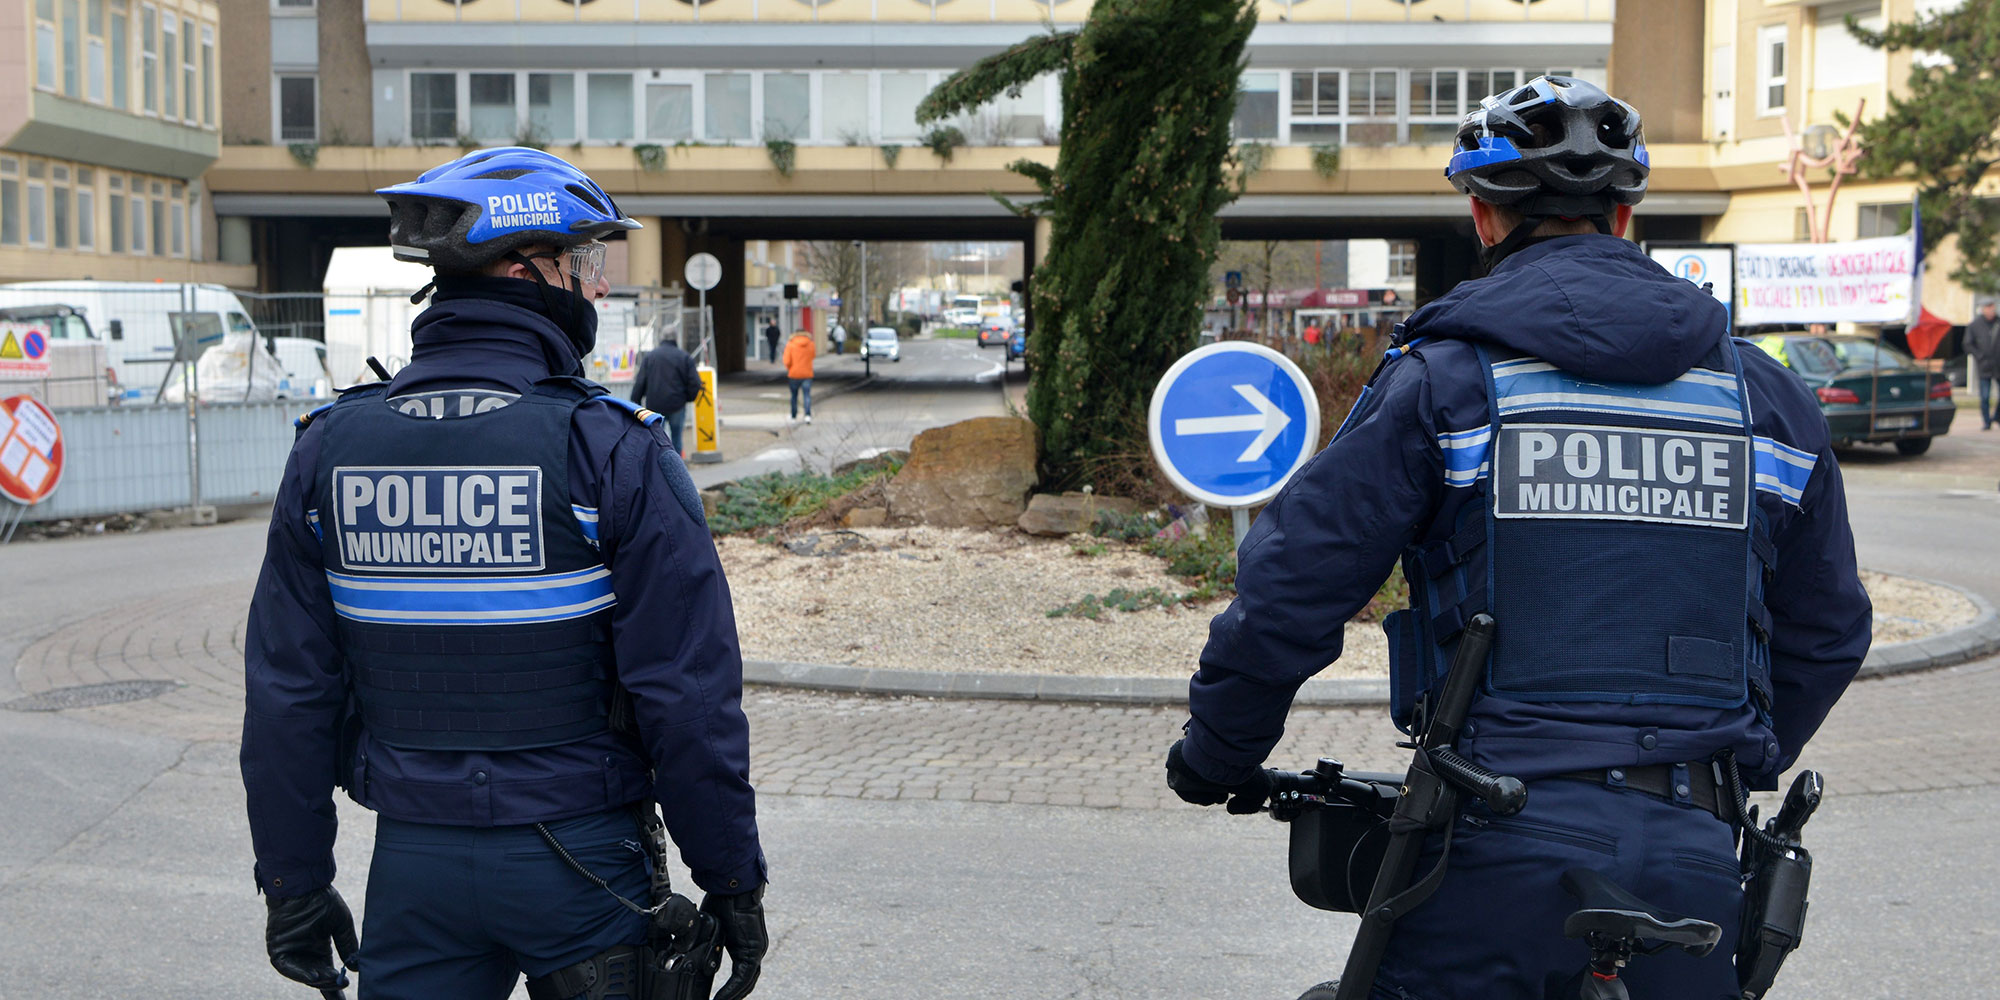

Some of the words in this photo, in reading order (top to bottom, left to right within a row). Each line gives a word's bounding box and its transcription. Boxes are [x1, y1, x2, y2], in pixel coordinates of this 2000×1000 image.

[487, 191, 559, 216] POLICE
[491, 211, 561, 229] MUNICIPALE
[1518, 431, 1730, 488] POLICE
[342, 474, 530, 527] POLICE
[1518, 483, 1729, 521] MUNICIPALE
[345, 531, 533, 564] MUNICIPALE
